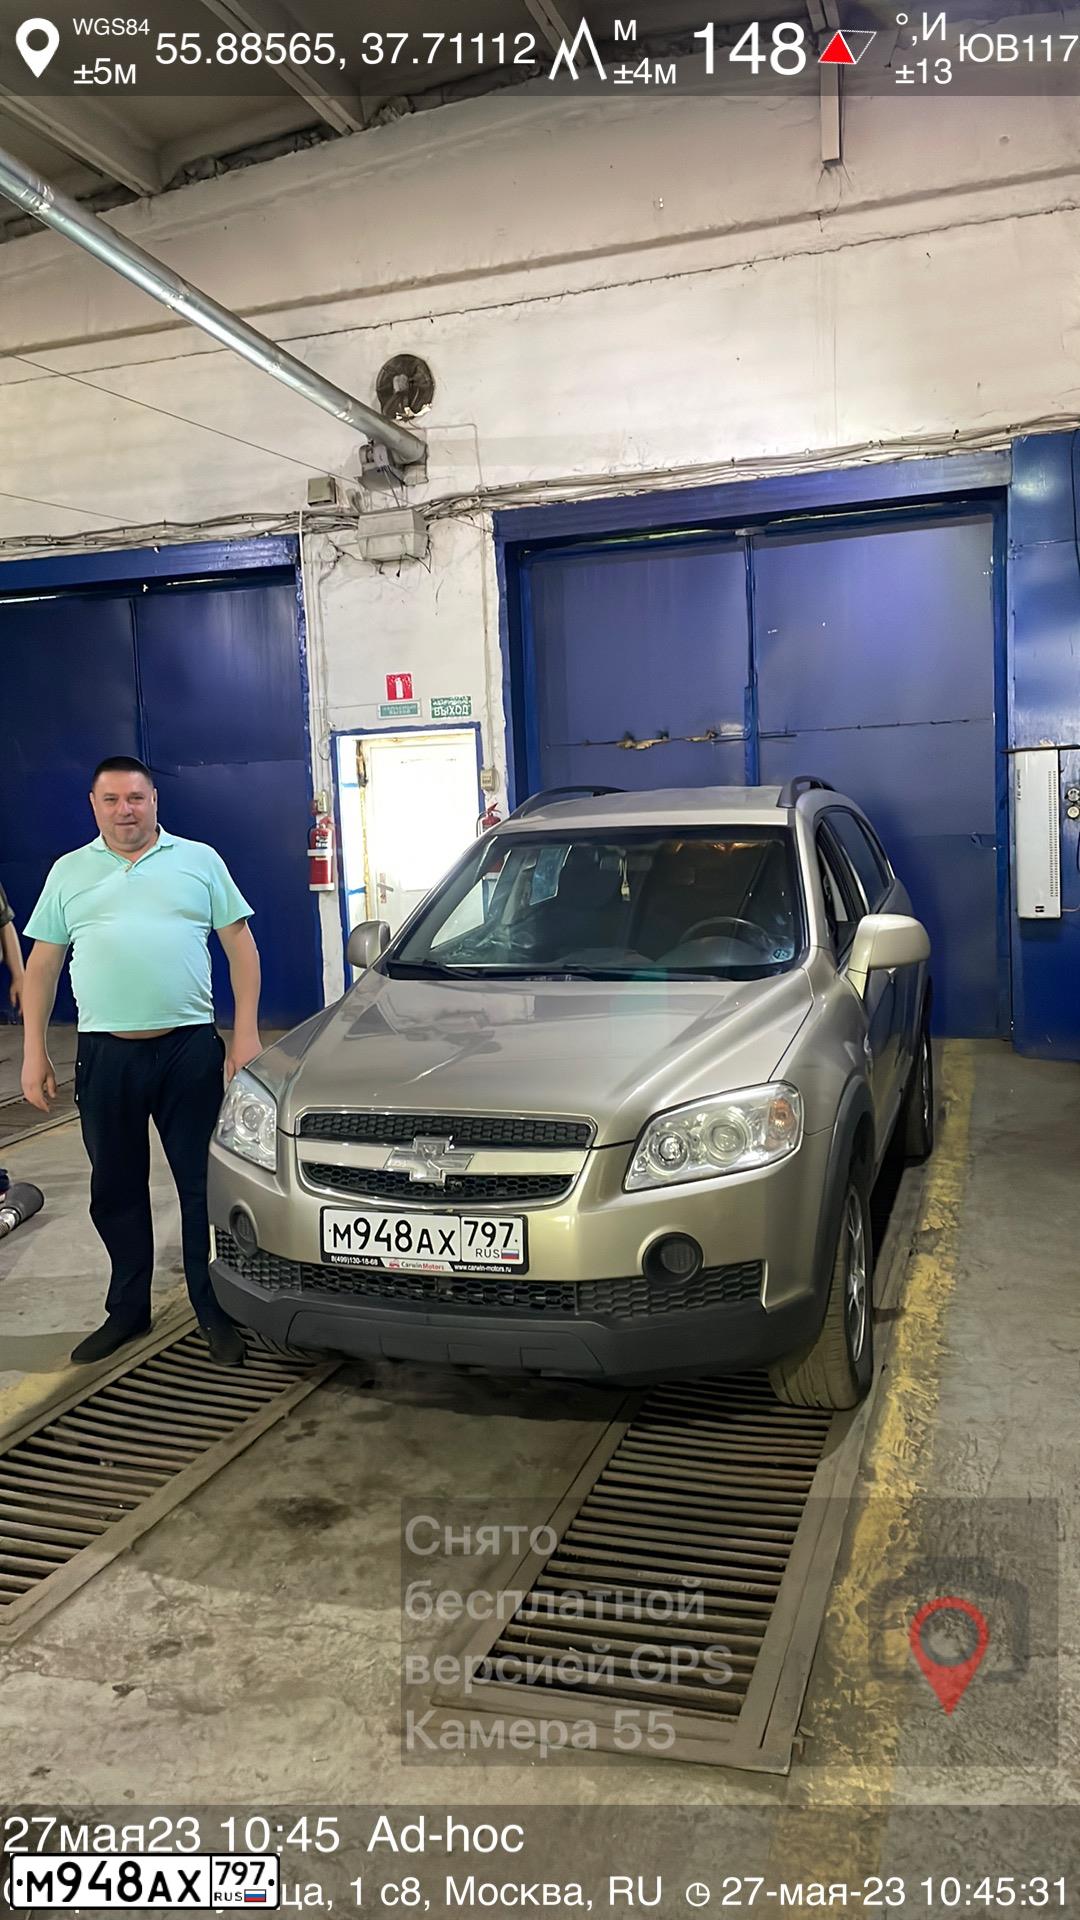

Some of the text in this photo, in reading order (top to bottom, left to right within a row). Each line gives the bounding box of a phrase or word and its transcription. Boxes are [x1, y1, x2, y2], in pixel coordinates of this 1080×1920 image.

[434, 704, 469, 716] ВЫХОД
[463, 1221, 514, 1249] 797
[475, 1248, 500, 1259] RUS
